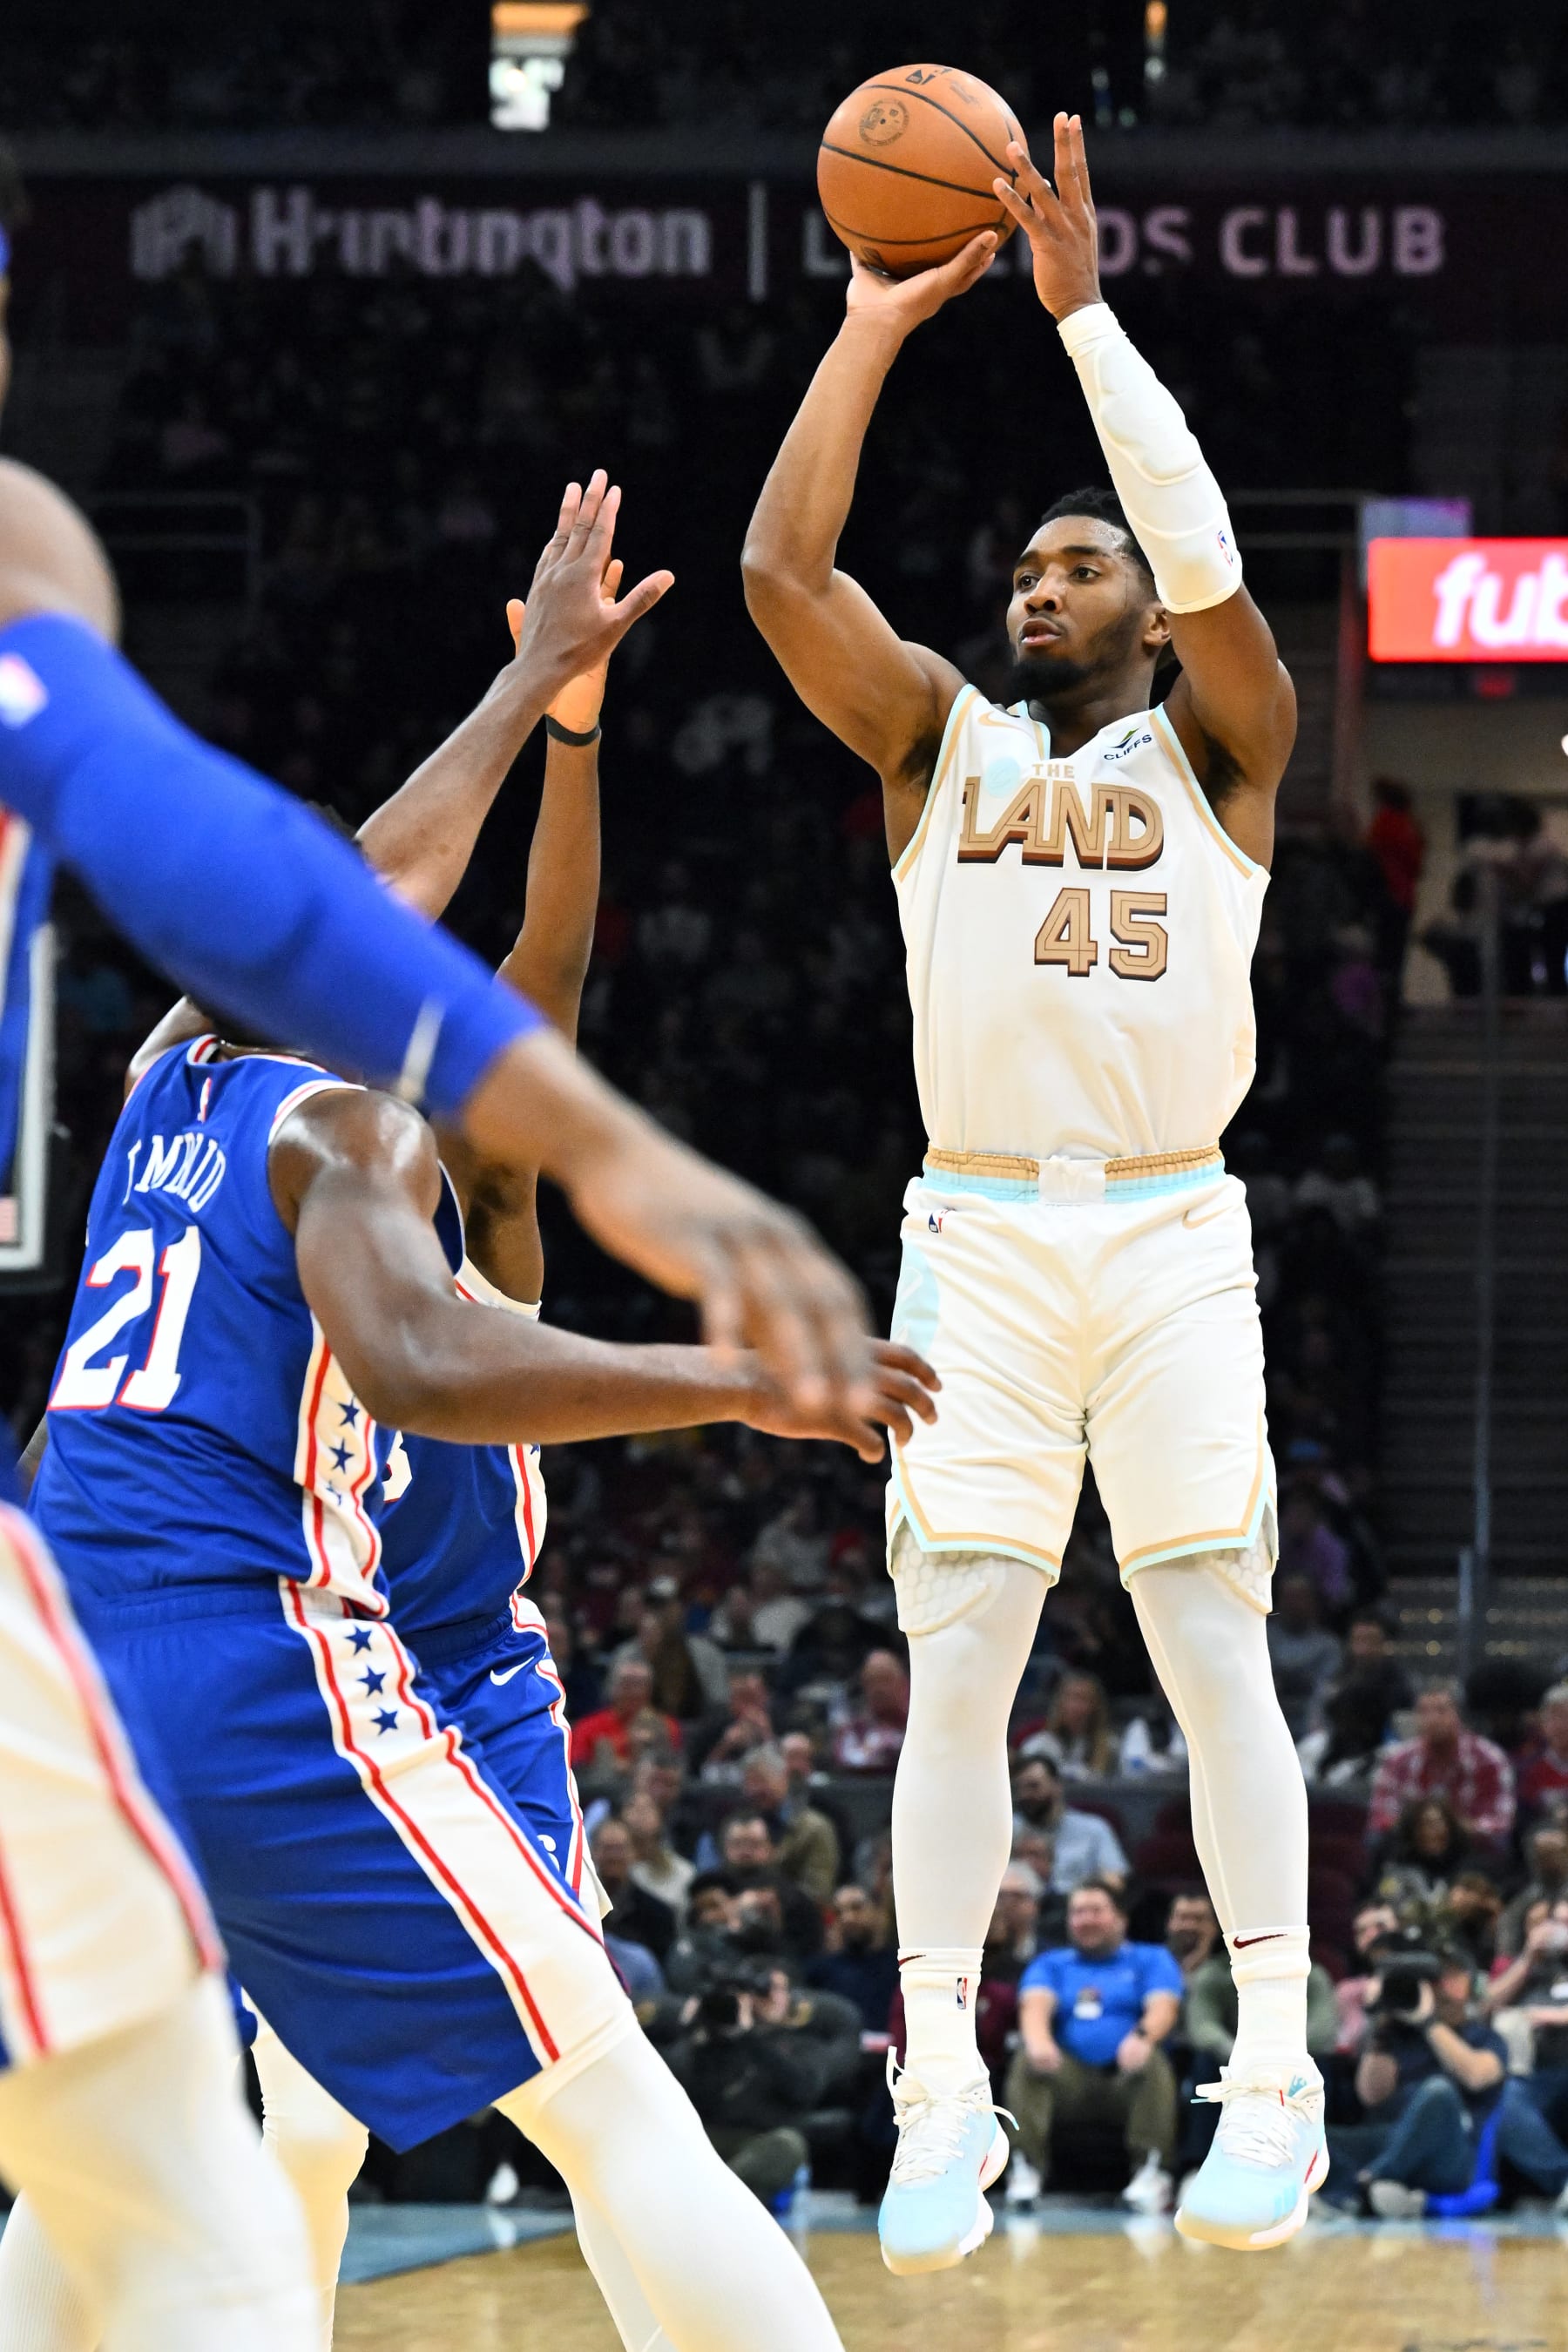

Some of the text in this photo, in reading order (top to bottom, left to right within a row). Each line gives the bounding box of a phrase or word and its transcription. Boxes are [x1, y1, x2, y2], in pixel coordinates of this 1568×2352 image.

[1222, 206, 1446, 277] CLUB
[1032, 764, 1074, 779] THE
[1104, 734, 1152, 760] CLIFFS
[957, 776, 1164, 871] LAND
[1034, 887, 1168, 982] 45
[48, 1227, 201, 1411] 21
